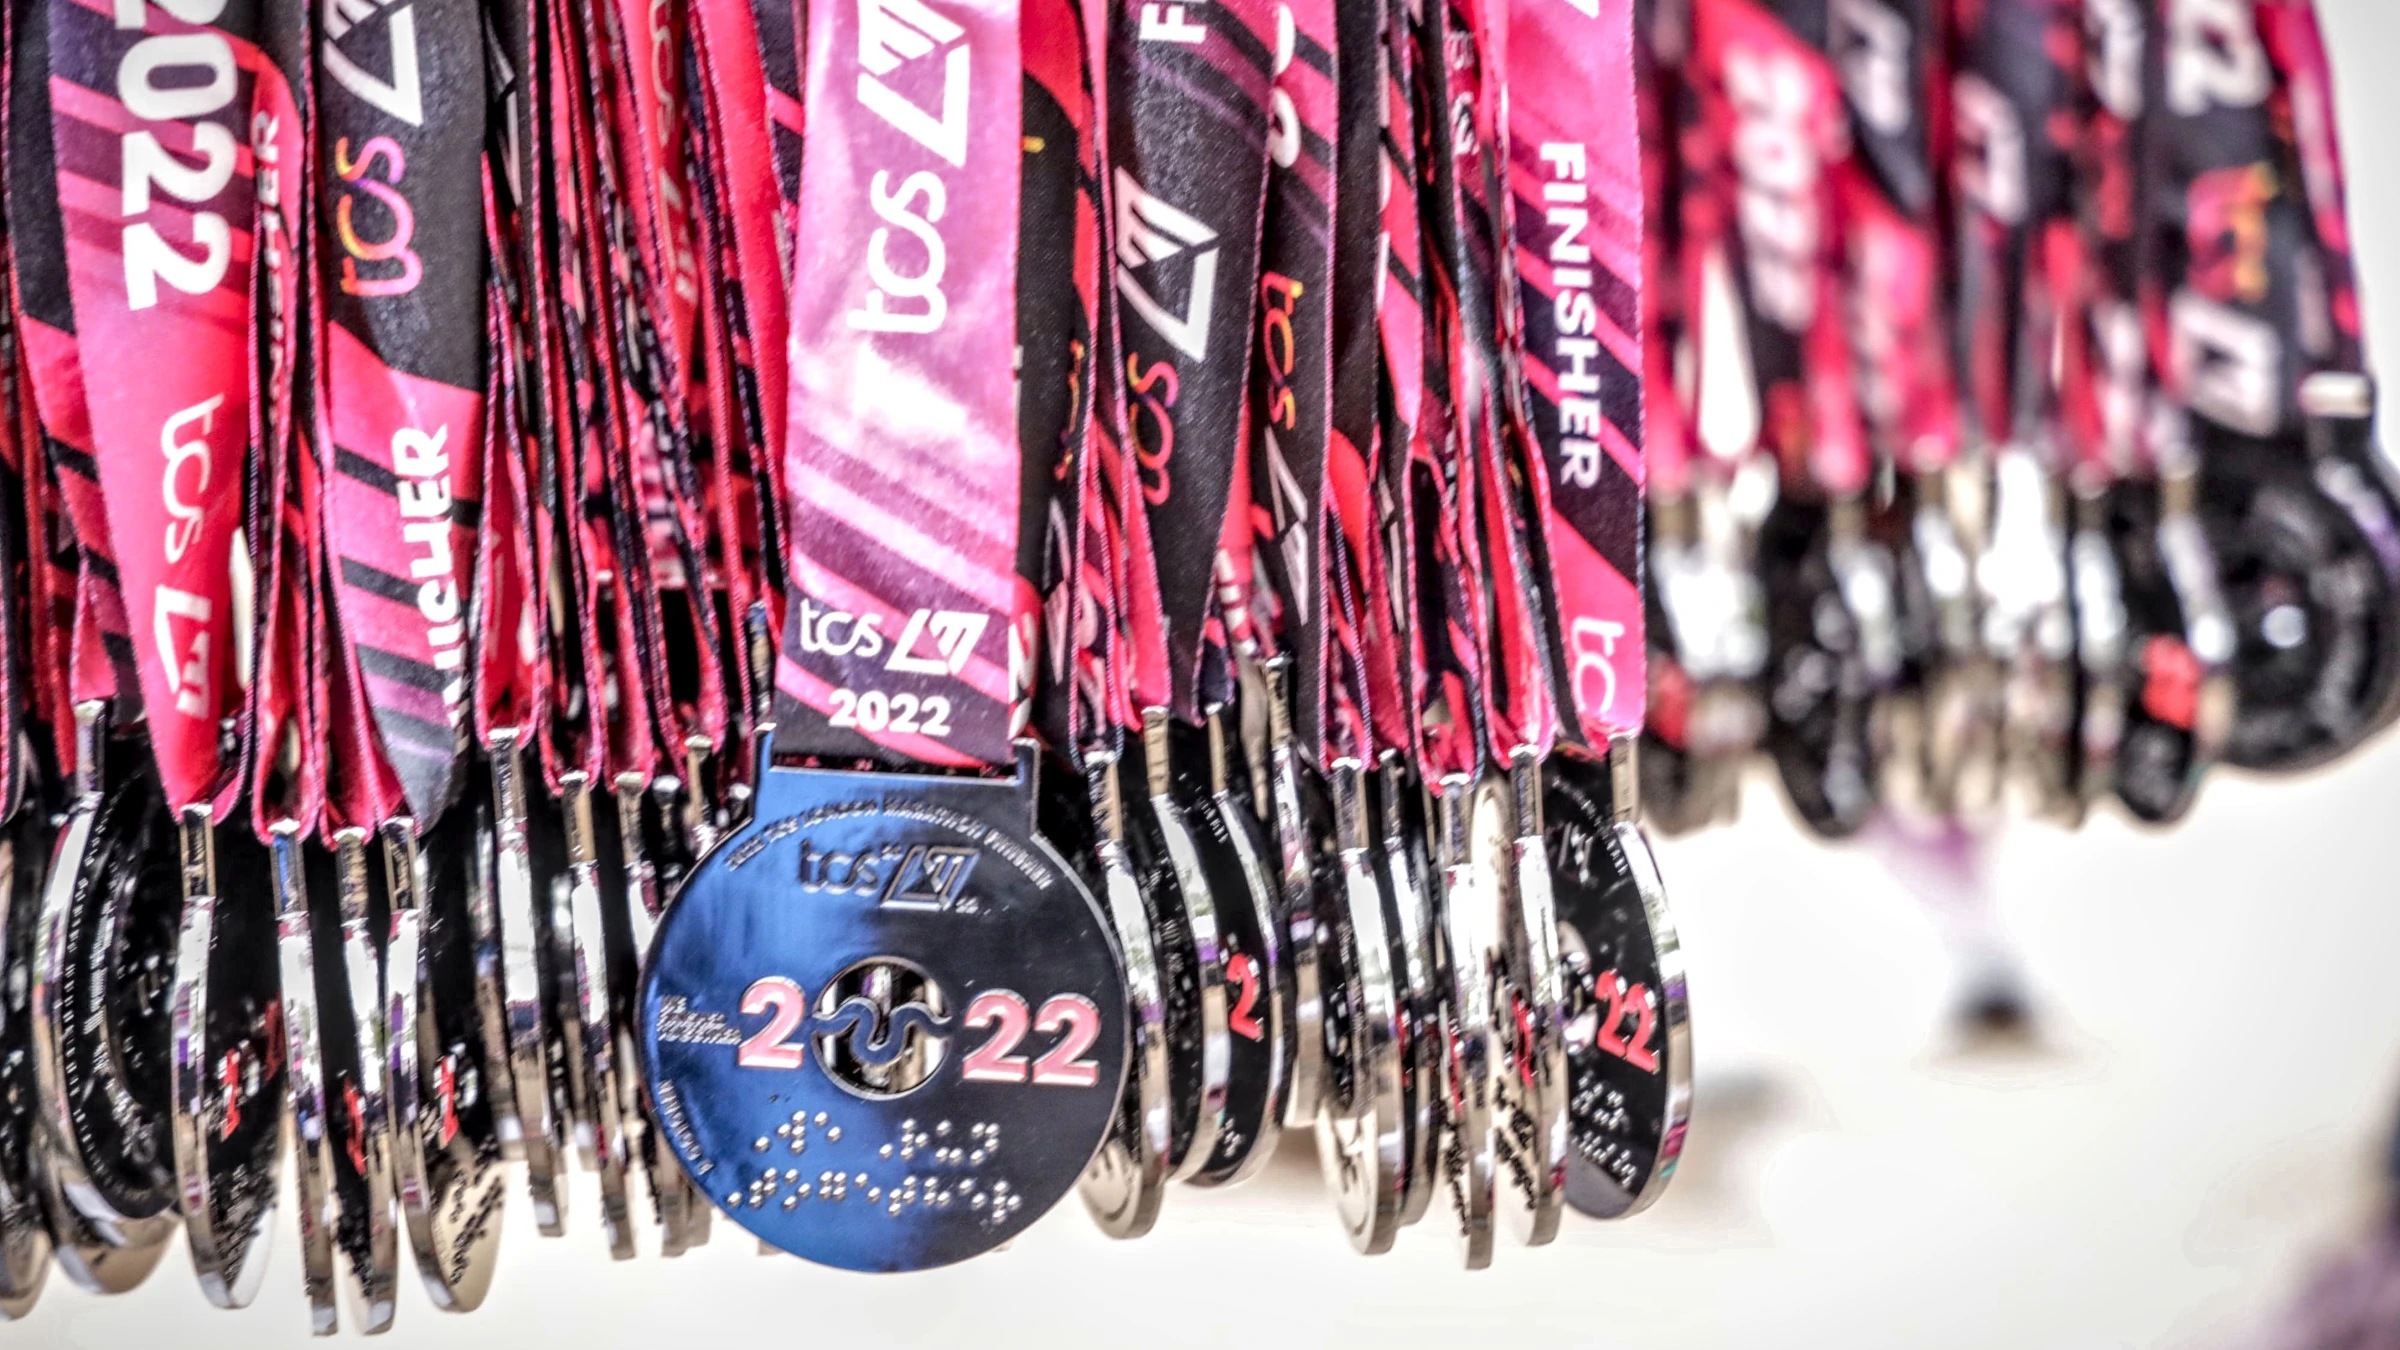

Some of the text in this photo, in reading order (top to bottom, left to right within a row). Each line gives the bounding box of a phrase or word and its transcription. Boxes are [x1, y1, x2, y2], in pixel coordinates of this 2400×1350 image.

[846, 169, 947, 334] tcs
[1540, 142, 1602, 490] FINISHER
[801, 599, 884, 658] tcs
[1571, 615, 1625, 714] tc
[828, 689, 952, 737] 2022
[799, 838, 879, 897] tcs
